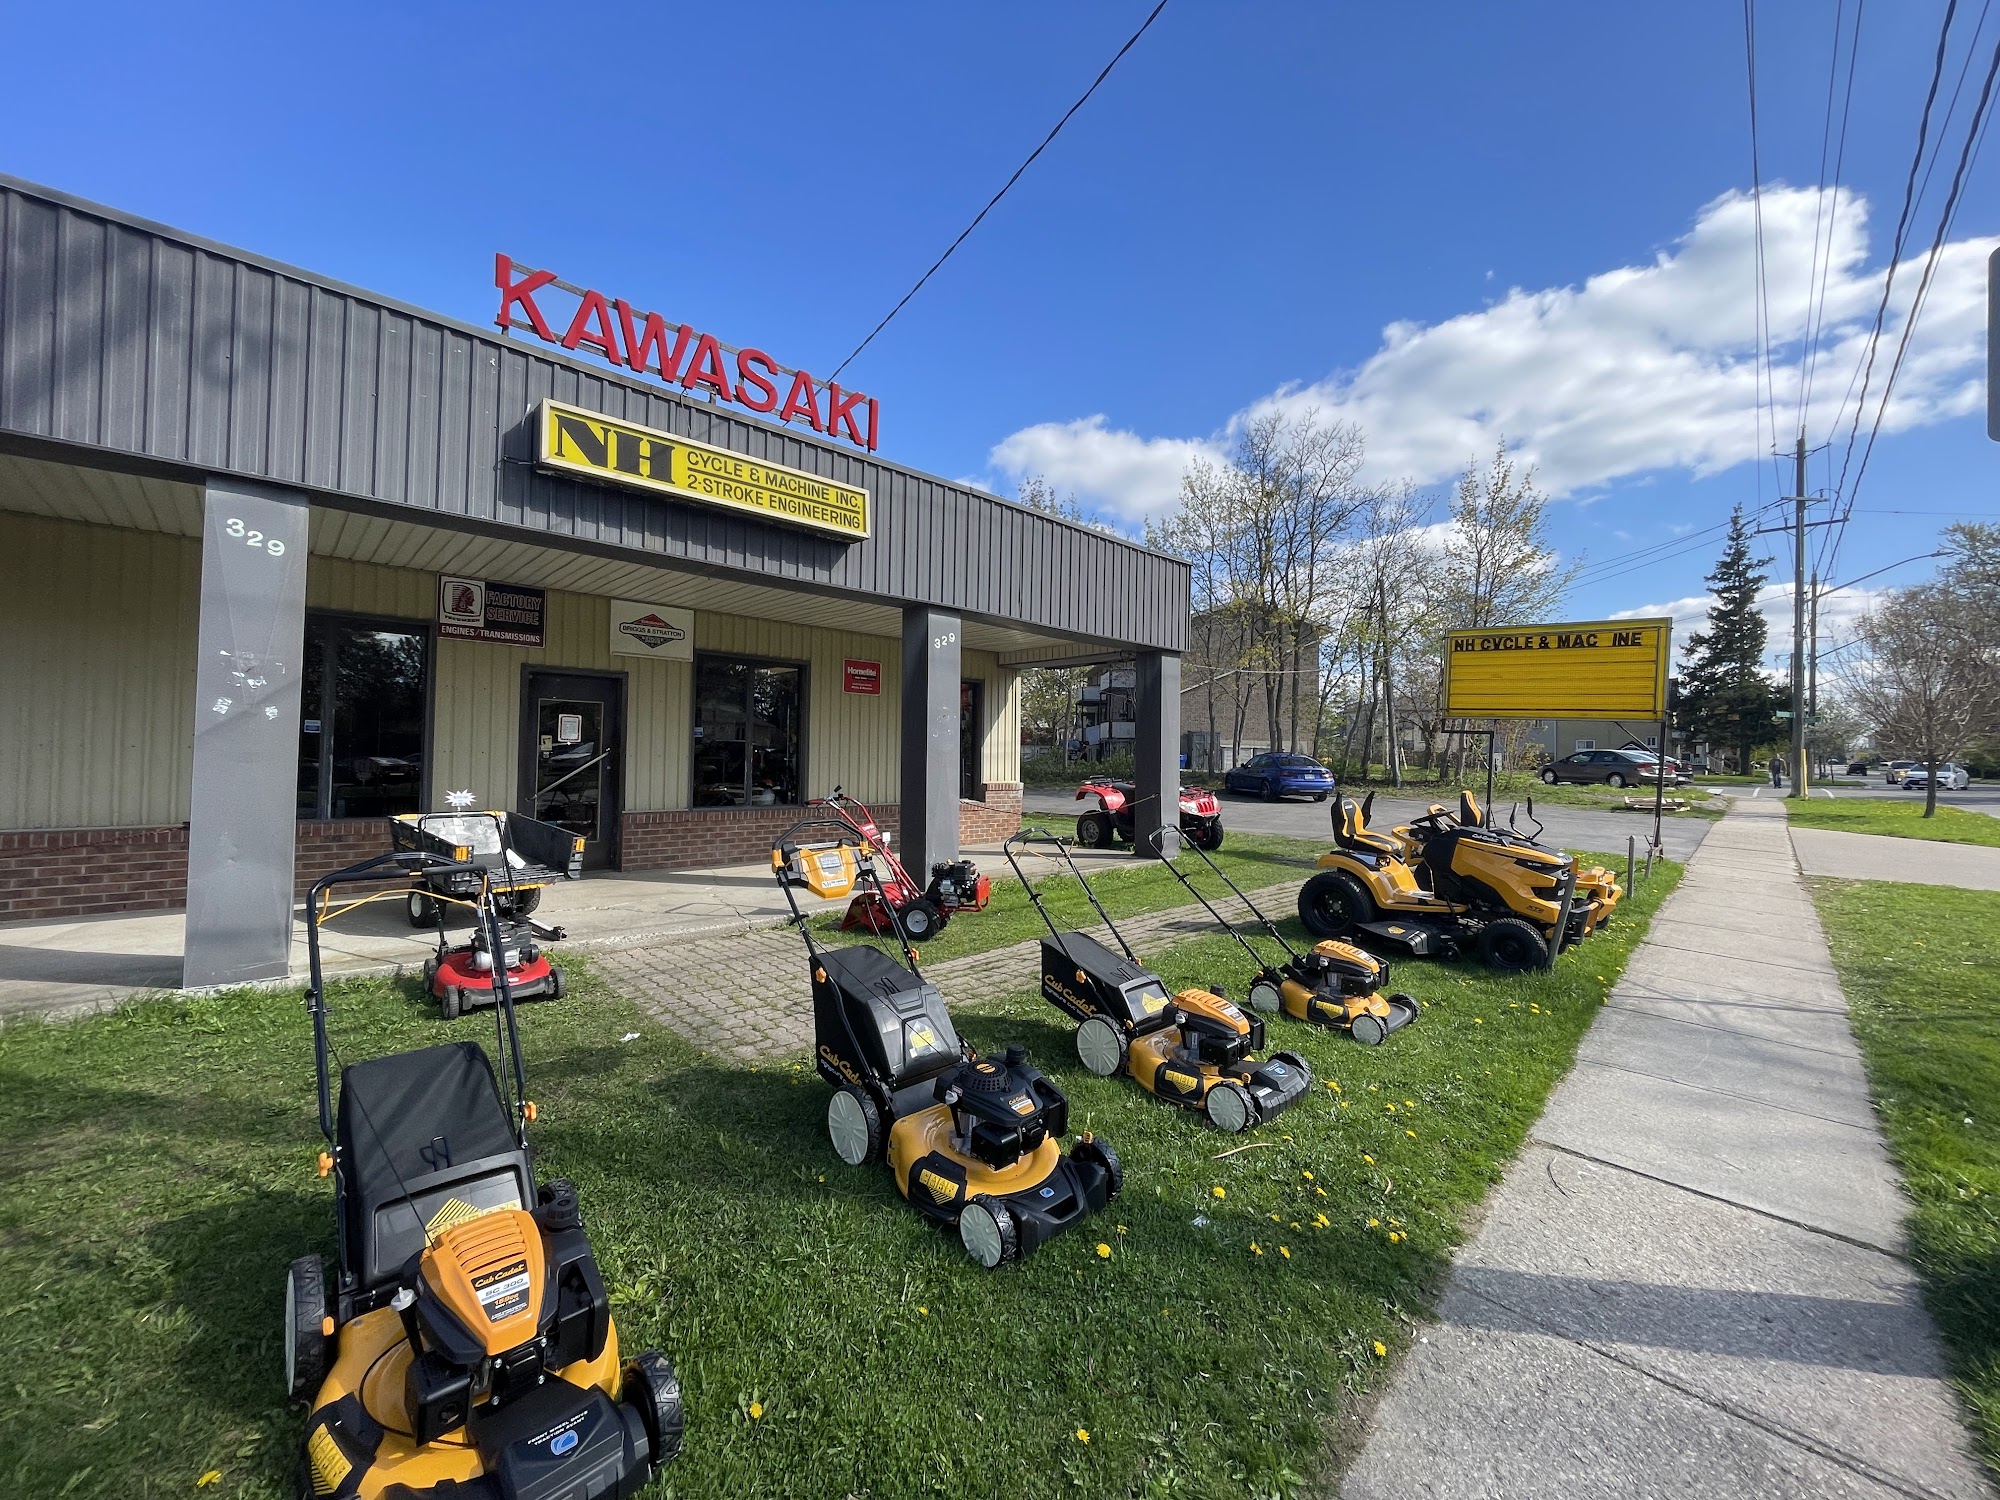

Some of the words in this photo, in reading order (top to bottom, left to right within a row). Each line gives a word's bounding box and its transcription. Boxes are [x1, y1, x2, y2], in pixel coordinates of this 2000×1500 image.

[495, 253, 880, 451] KAWASAKI
[554, 413, 677, 485] NH
[687, 450, 743, 478] CYCLE
[749, 467, 760, 483] &
[765, 472, 830, 501] MACHINE
[836, 490, 861, 509] INC.
[687, 474, 764, 506] 2-STROKE
[769, 495, 861, 529] ENGINEERING
[226, 518, 285, 556] 329
[485, 590, 542, 611] FACTORY
[486, 607, 539, 625] SERVICE
[441, 625, 541, 643] ENGINES/TRANSMISSIONS
[622, 625, 646, 634] BRIGGS
[652, 629, 682, 637] STRATTON
[934, 632, 955, 649] 329
[1455, 638, 1475, 651] NH
[1539, 636, 1550, 649] &
[1557, 633, 1598, 649] MAC
[1044, 974, 1063, 992] Cub
[1063, 988, 1097, 1016] Cadet
[820, 1045, 839, 1066] Cub
[839, 1060, 863, 1086] Cade
[475, 1275, 494, 1288] Cub
[494, 1263, 525, 1280] Cadet
[503, 1278, 524, 1289] 300
